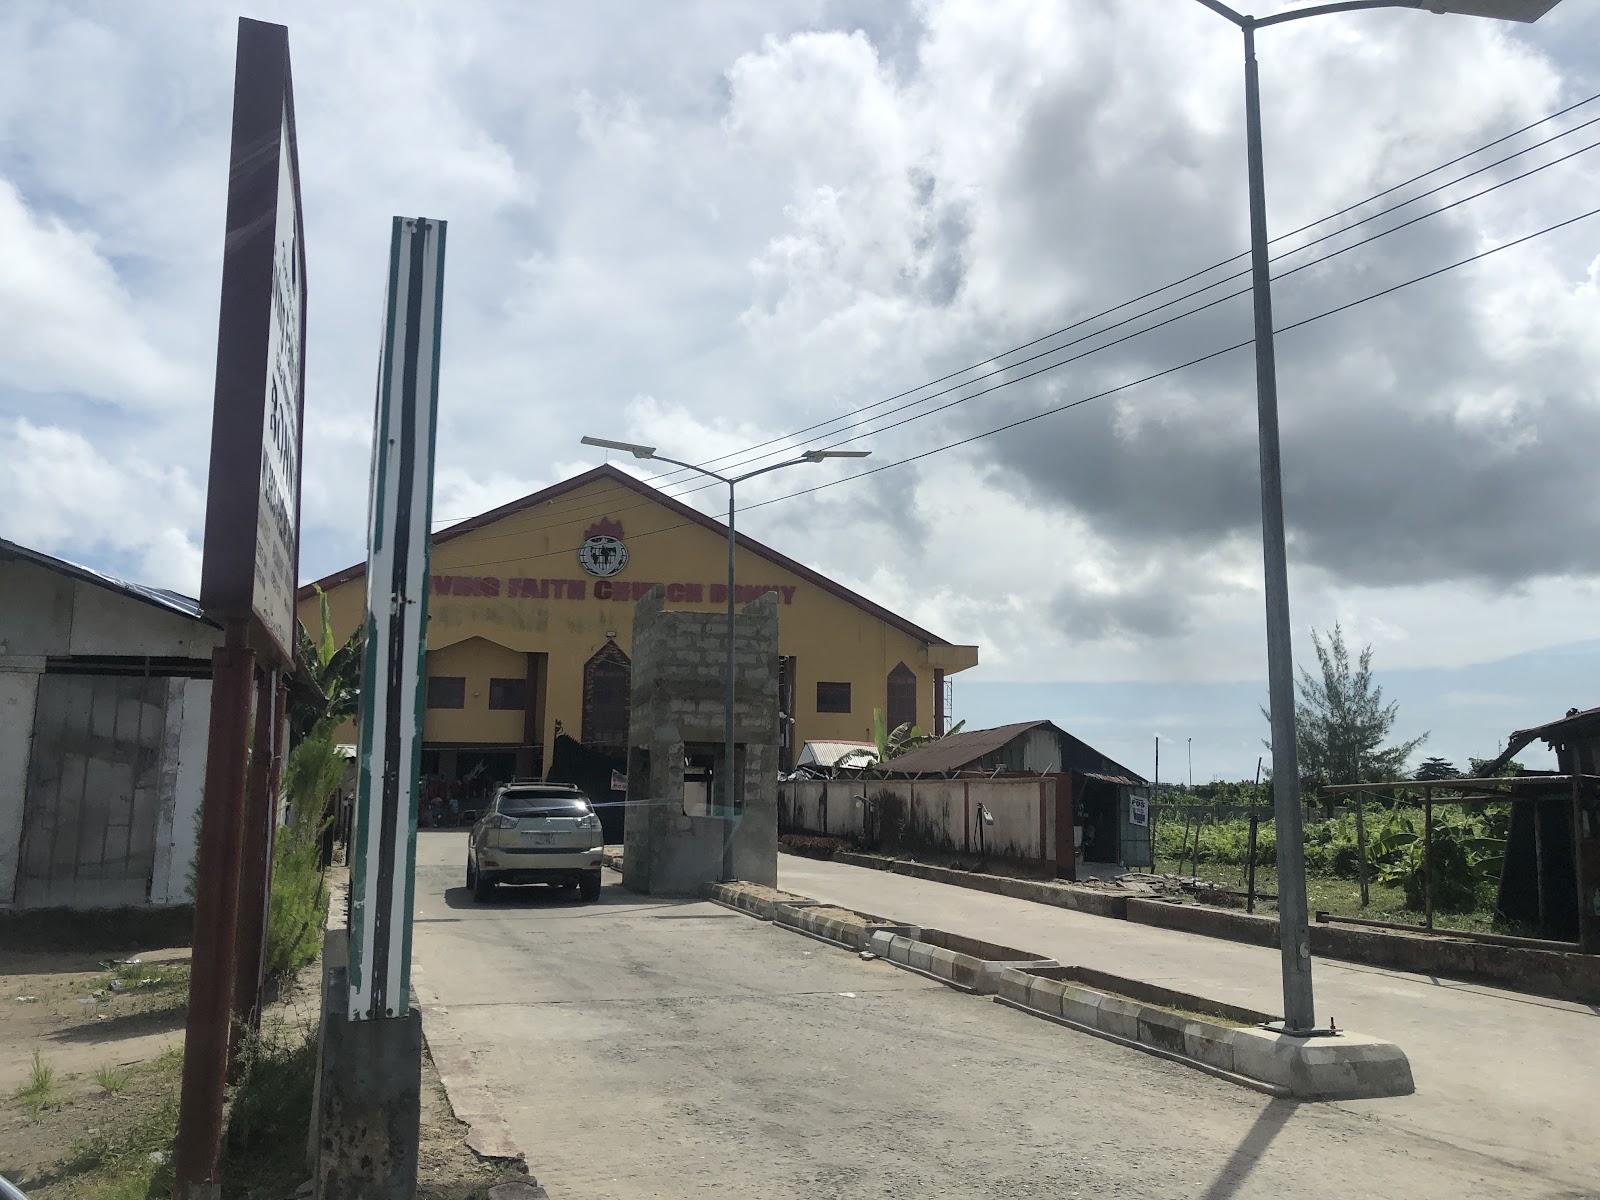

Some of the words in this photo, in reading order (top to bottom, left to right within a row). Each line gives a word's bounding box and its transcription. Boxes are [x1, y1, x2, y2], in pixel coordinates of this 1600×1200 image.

[270, 373, 293, 504] BONN
[429, 576, 500, 597] VING
[506, 577, 586, 601] FAITH
[594, 580, 703, 602] CHUCH
